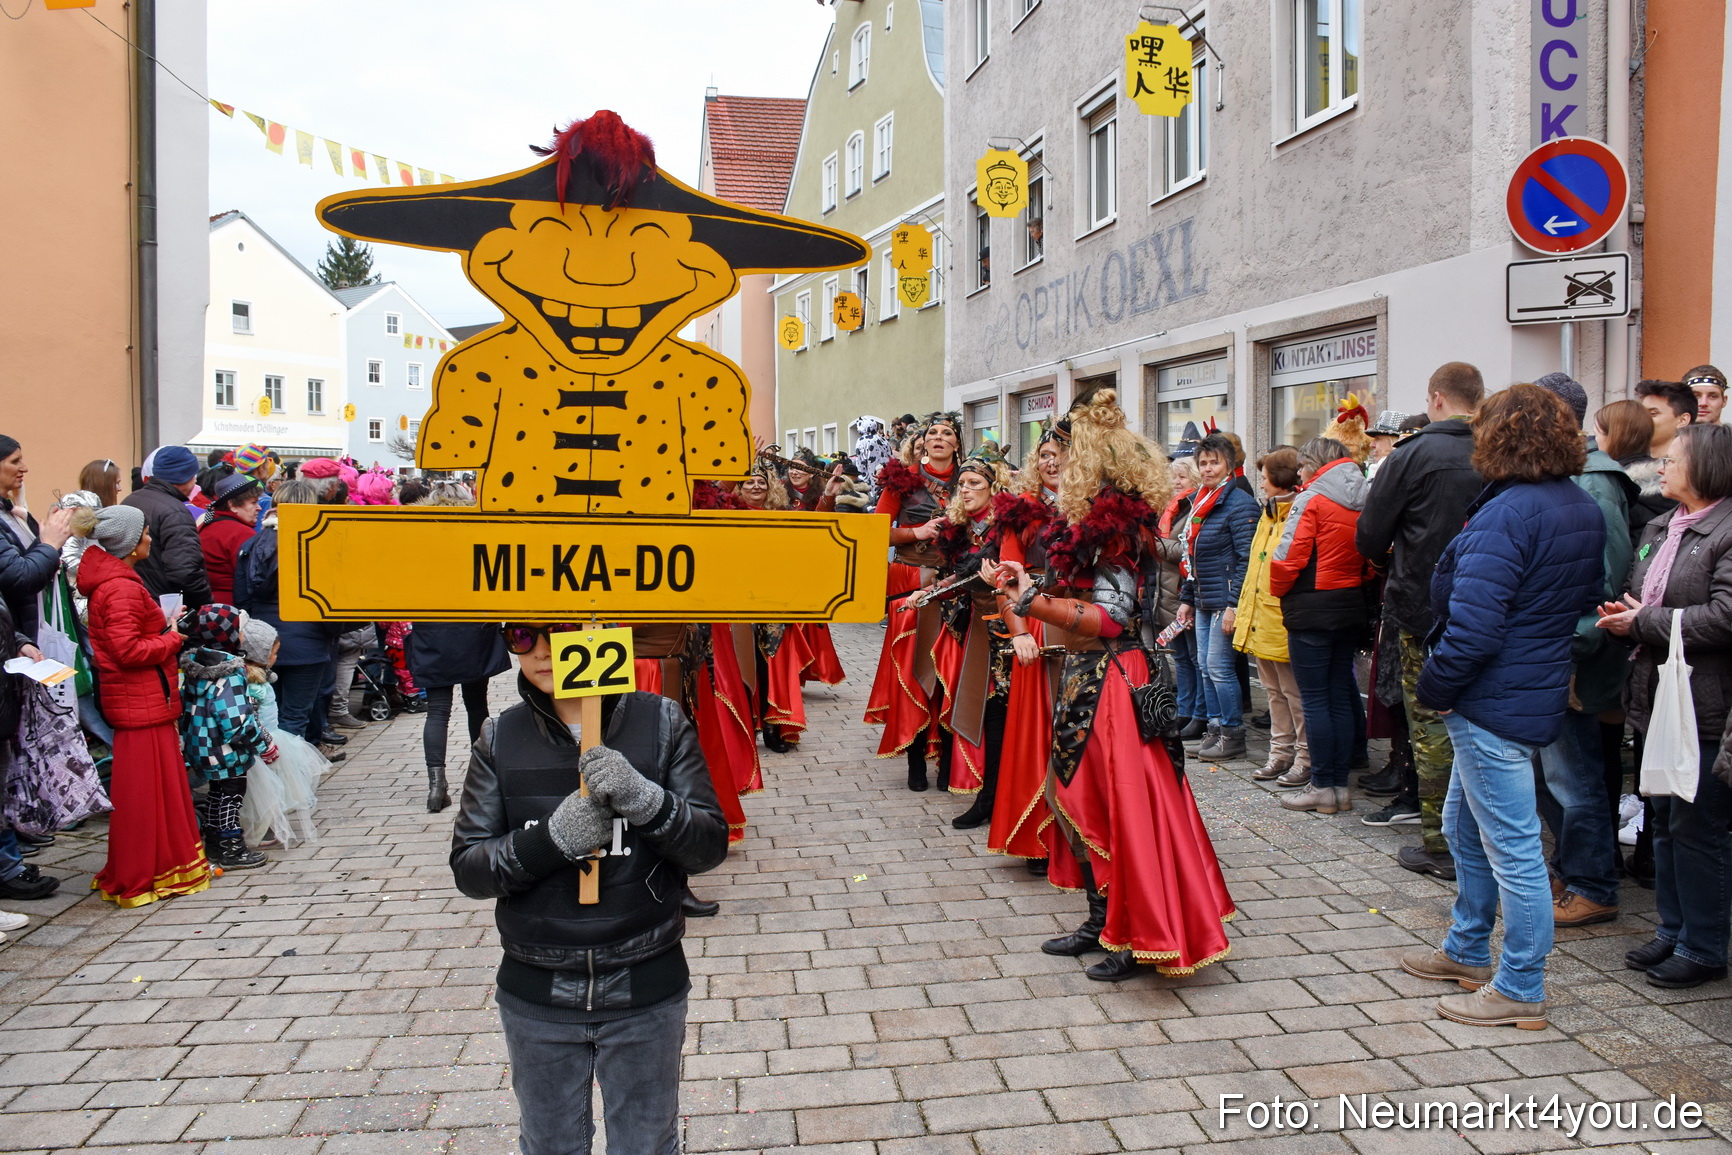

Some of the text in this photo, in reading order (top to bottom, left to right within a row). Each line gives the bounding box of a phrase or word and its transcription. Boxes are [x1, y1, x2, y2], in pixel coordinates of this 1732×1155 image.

[1015, 216, 1212, 350] OPTIK OEXL
[213, 421, 255, 433] Schuhmoden
[472, 543, 695, 592] MI-KA-DO
[559, 641, 630, 690] 22
